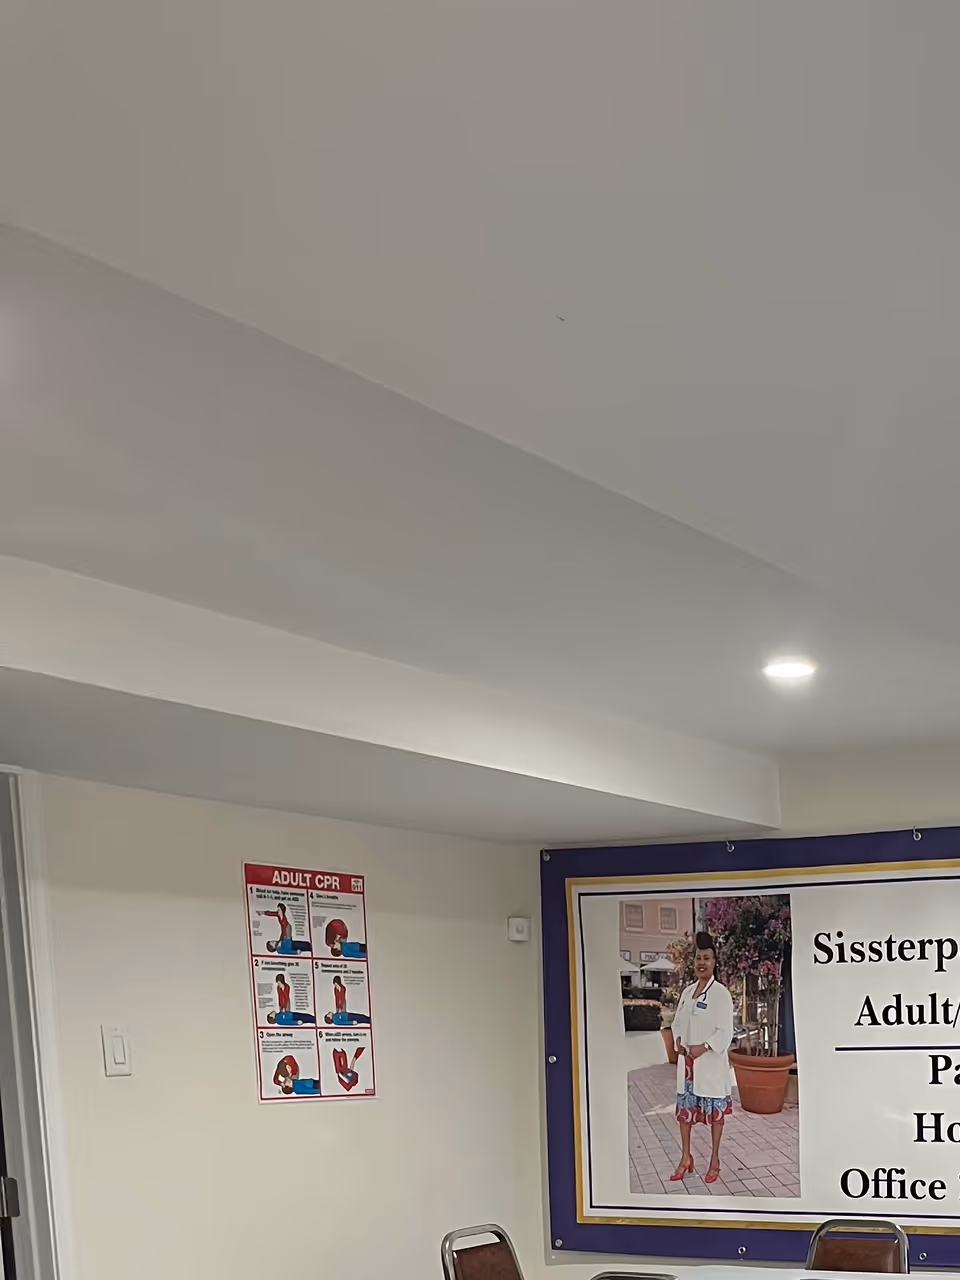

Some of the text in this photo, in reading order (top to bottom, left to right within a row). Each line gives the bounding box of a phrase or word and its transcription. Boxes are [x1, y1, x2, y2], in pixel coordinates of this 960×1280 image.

[272, 870, 341, 890] ADULT CPR
[254, 959, 260, 968] 2
[314, 962, 319, 970] 5
[259, 1031, 265, 1039] 3
[318, 1031, 324, 1039] 6
[840, 1167, 947, 1201] Office
